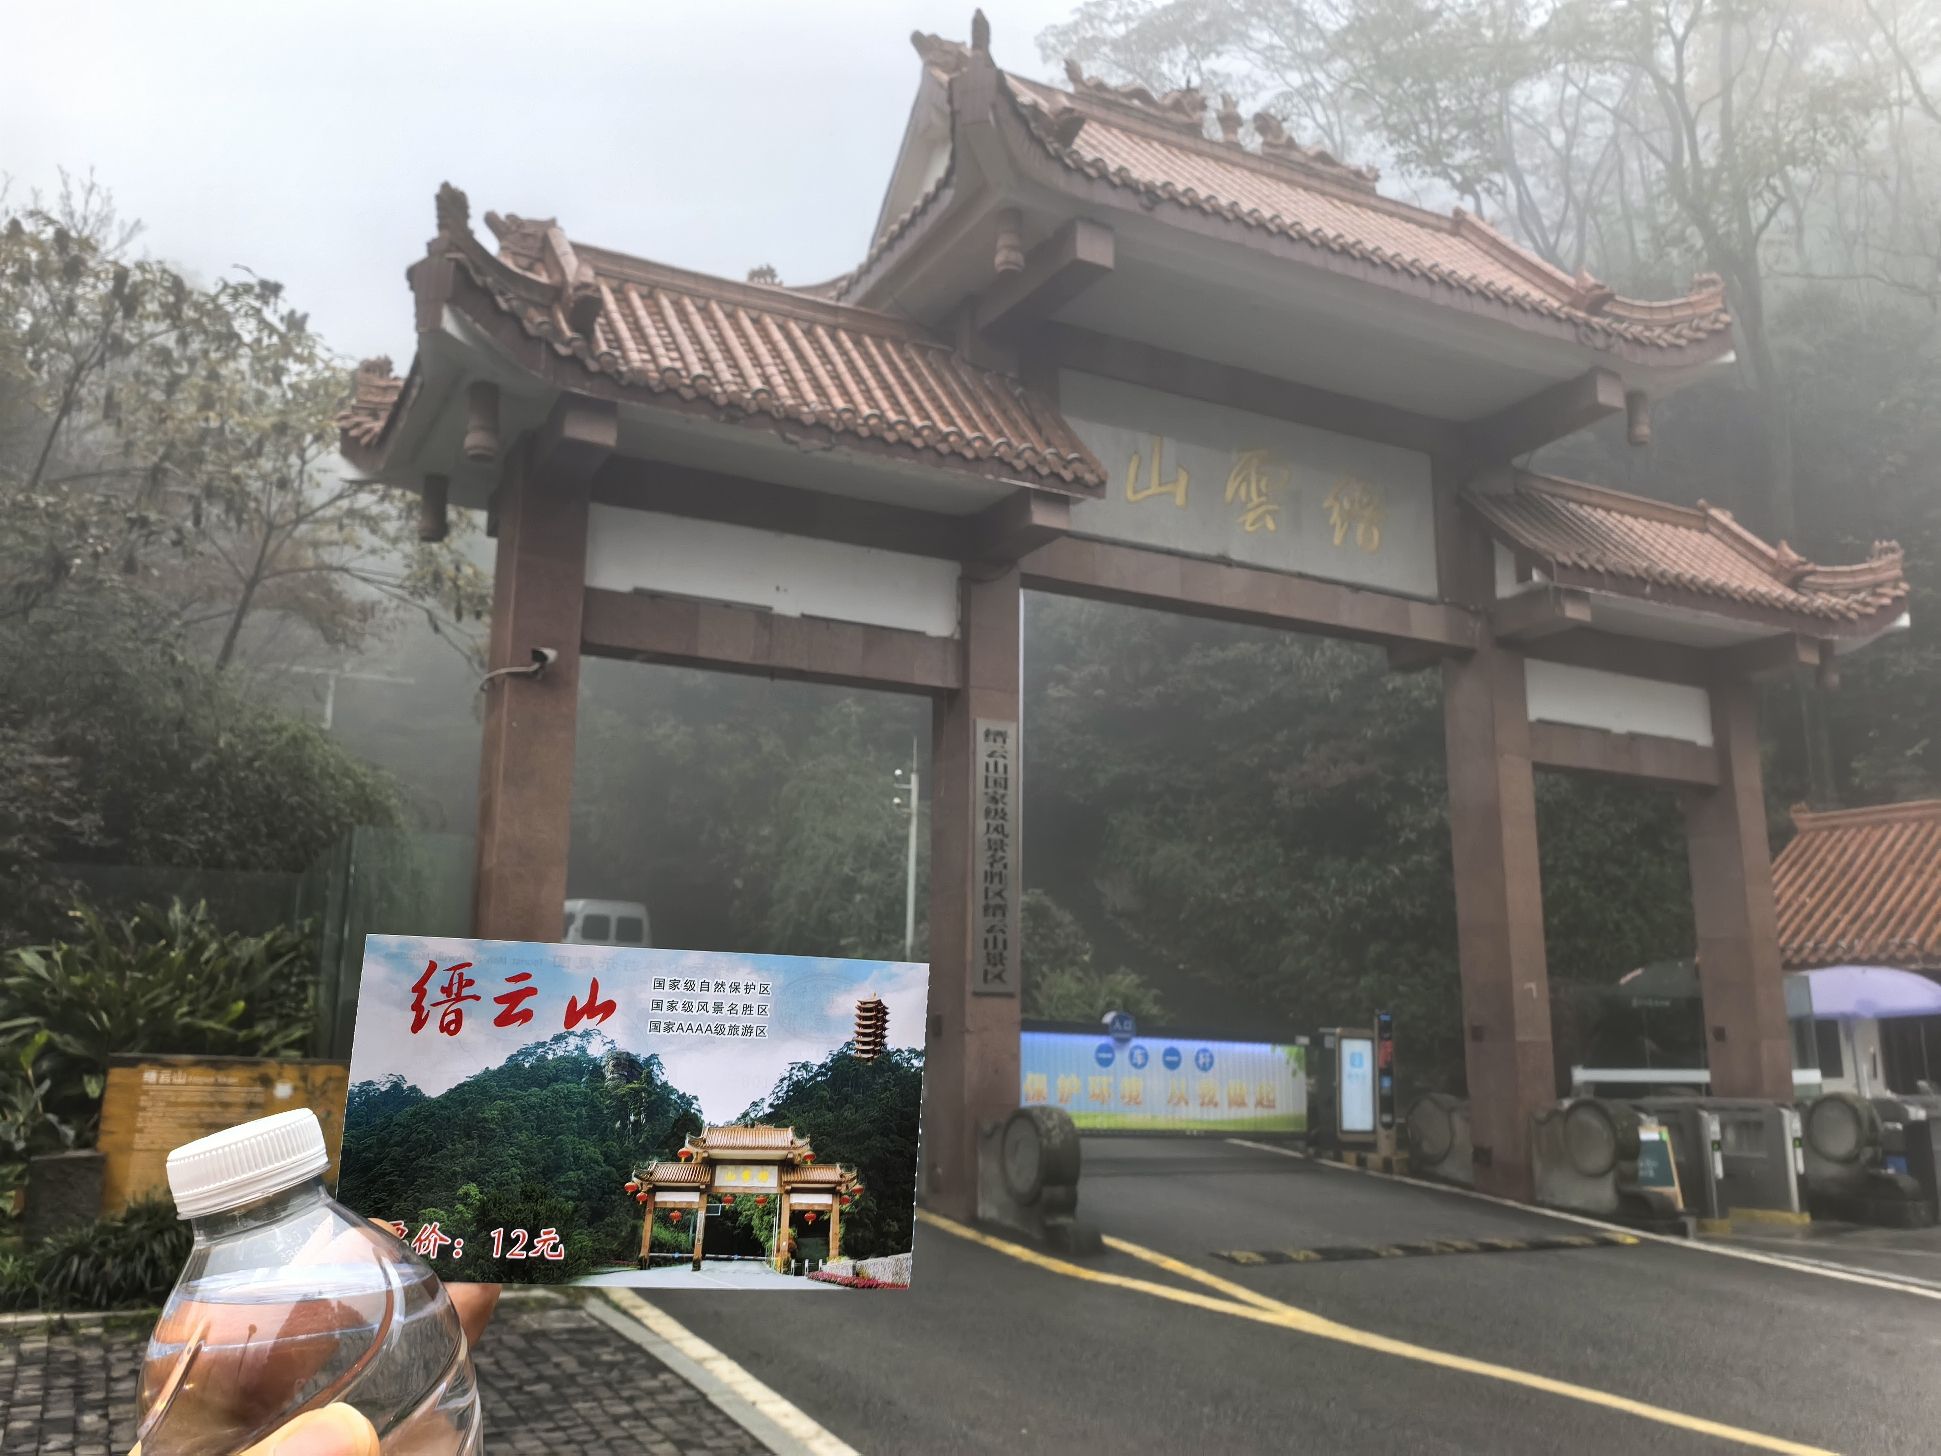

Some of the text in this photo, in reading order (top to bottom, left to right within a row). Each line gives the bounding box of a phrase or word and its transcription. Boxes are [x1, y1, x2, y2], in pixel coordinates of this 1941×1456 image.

[652, 977, 772, 996] 国家级自然保护区
[410, 960, 617, 1037] 缙云山
[650, 999, 769, 1017] 国家级风景名胜区
[648, 1020, 768, 1038] 国家AAAA级旅游区
